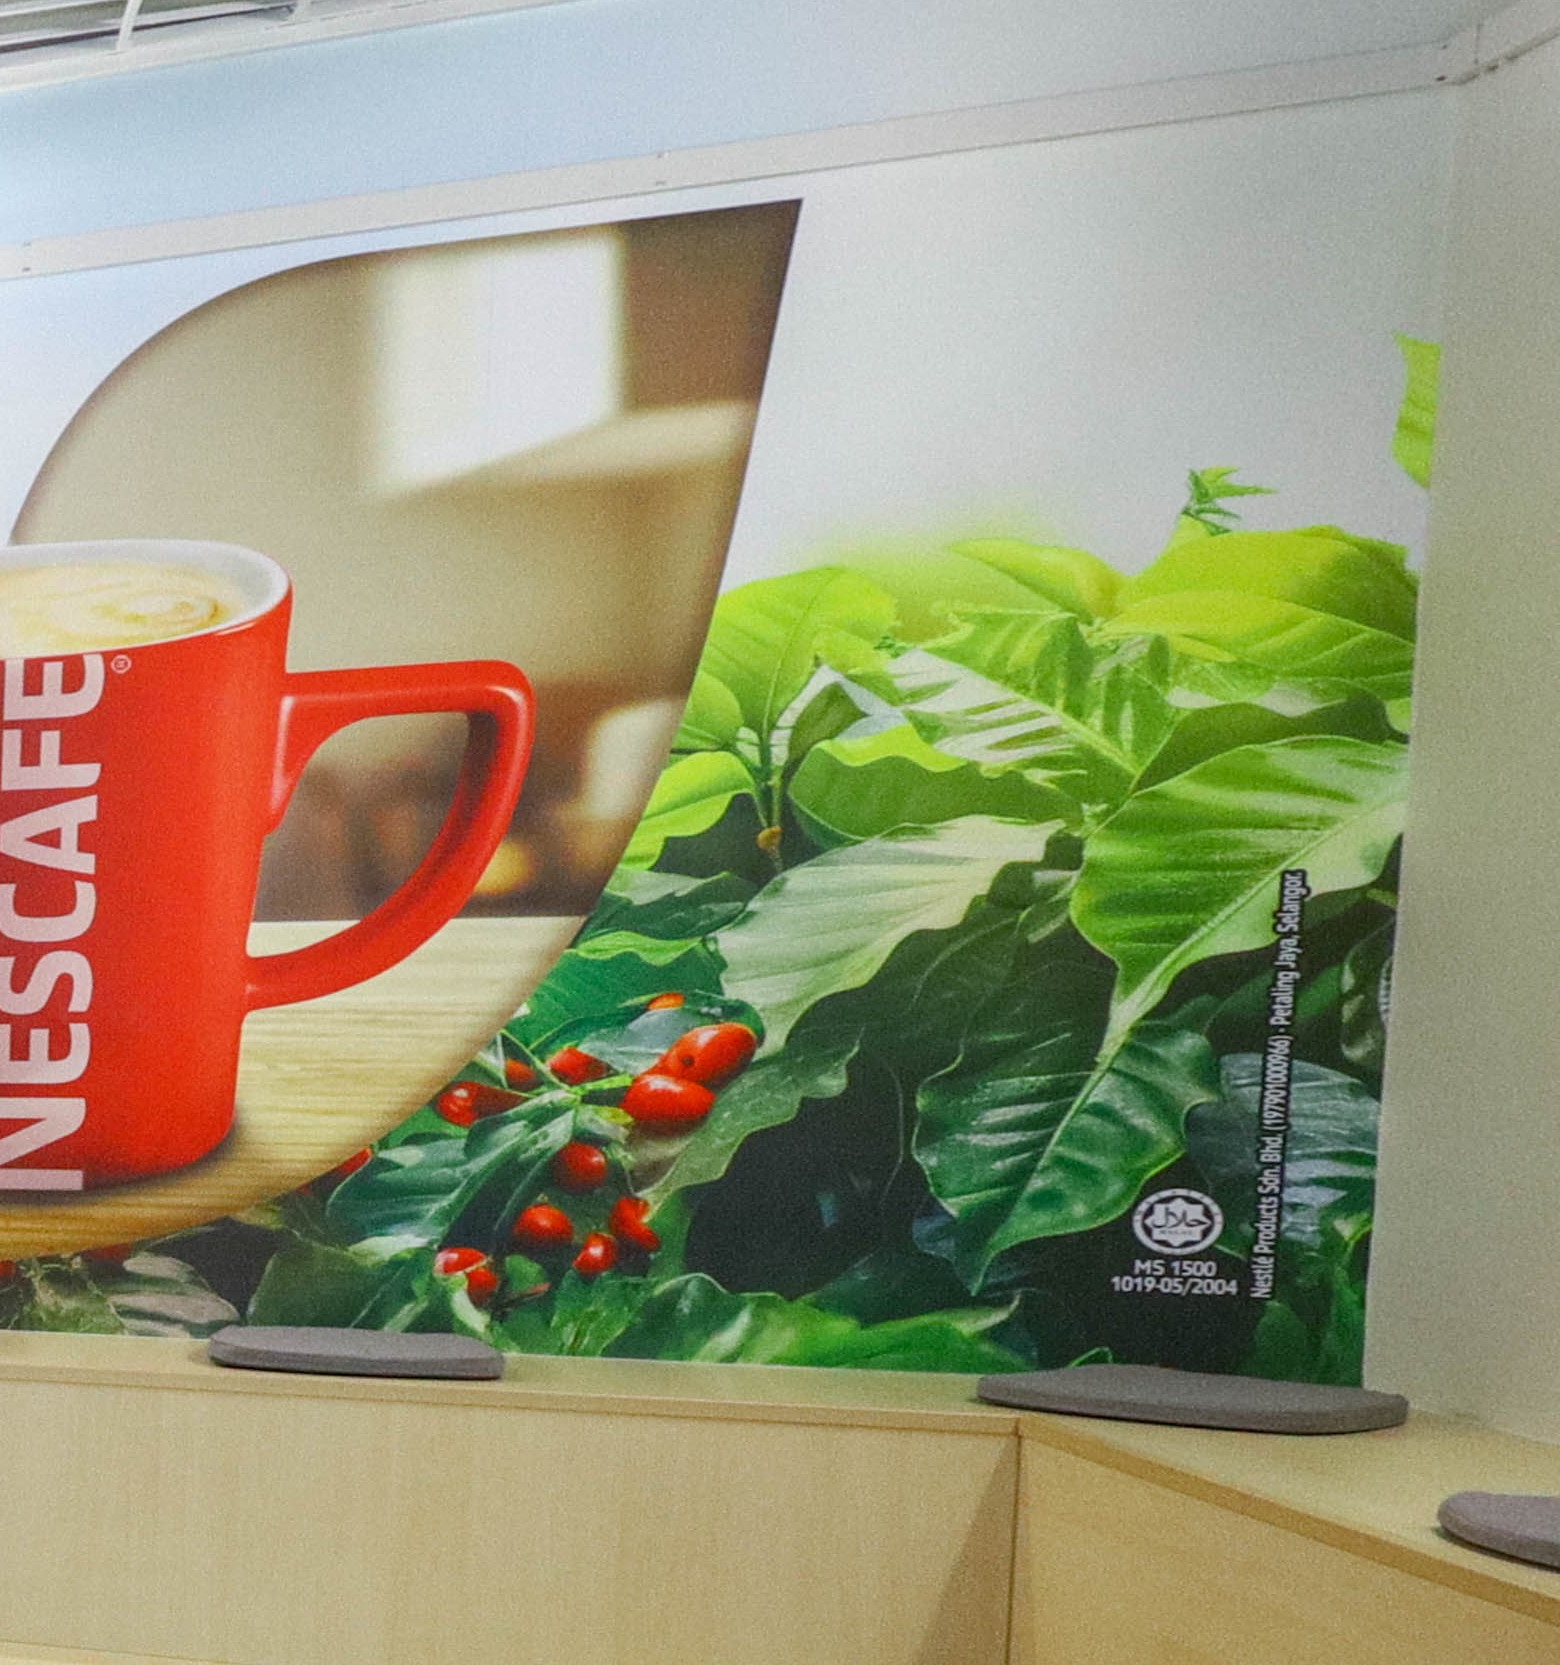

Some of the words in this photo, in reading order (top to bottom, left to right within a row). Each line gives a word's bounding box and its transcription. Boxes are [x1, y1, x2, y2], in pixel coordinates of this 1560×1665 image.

[1268, 972, 1300, 1026] Petaling
[1259, 1135, 1284, 1163] Bhd.
[1258, 1166, 1281, 1195] Sdn.
[1252, 1197, 1280, 1254] Products
[1133, 1259, 1165, 1276] MS
[1170, 1260, 1218, 1277] 1500
[1250, 1257, 1276, 1299] Nestlé
[1111, 1275, 1238, 1296] 1019-05/2004
